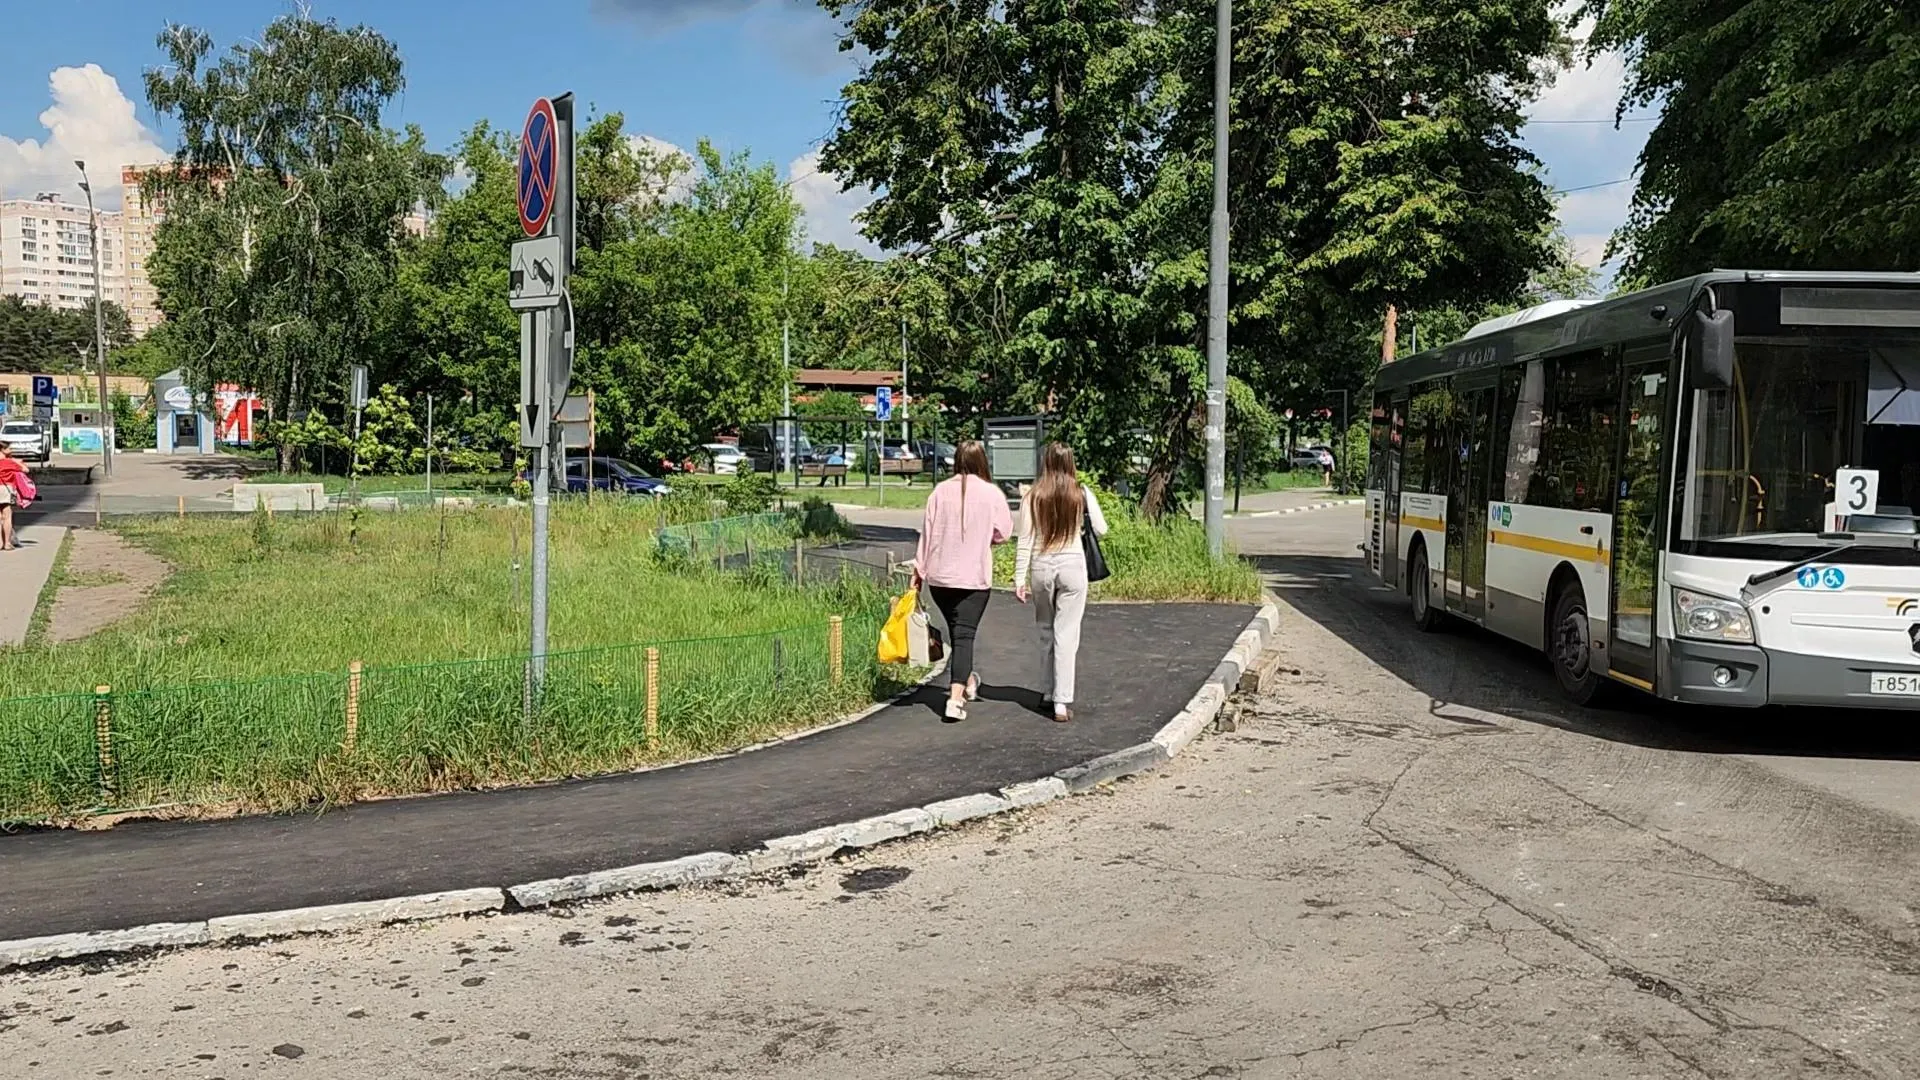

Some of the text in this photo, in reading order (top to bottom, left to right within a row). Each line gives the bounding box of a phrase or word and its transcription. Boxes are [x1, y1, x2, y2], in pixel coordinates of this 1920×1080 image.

[37, 378, 48, 394] P
[1848, 475, 1867, 511] 3
[1876, 676, 1920, 692] Т851
